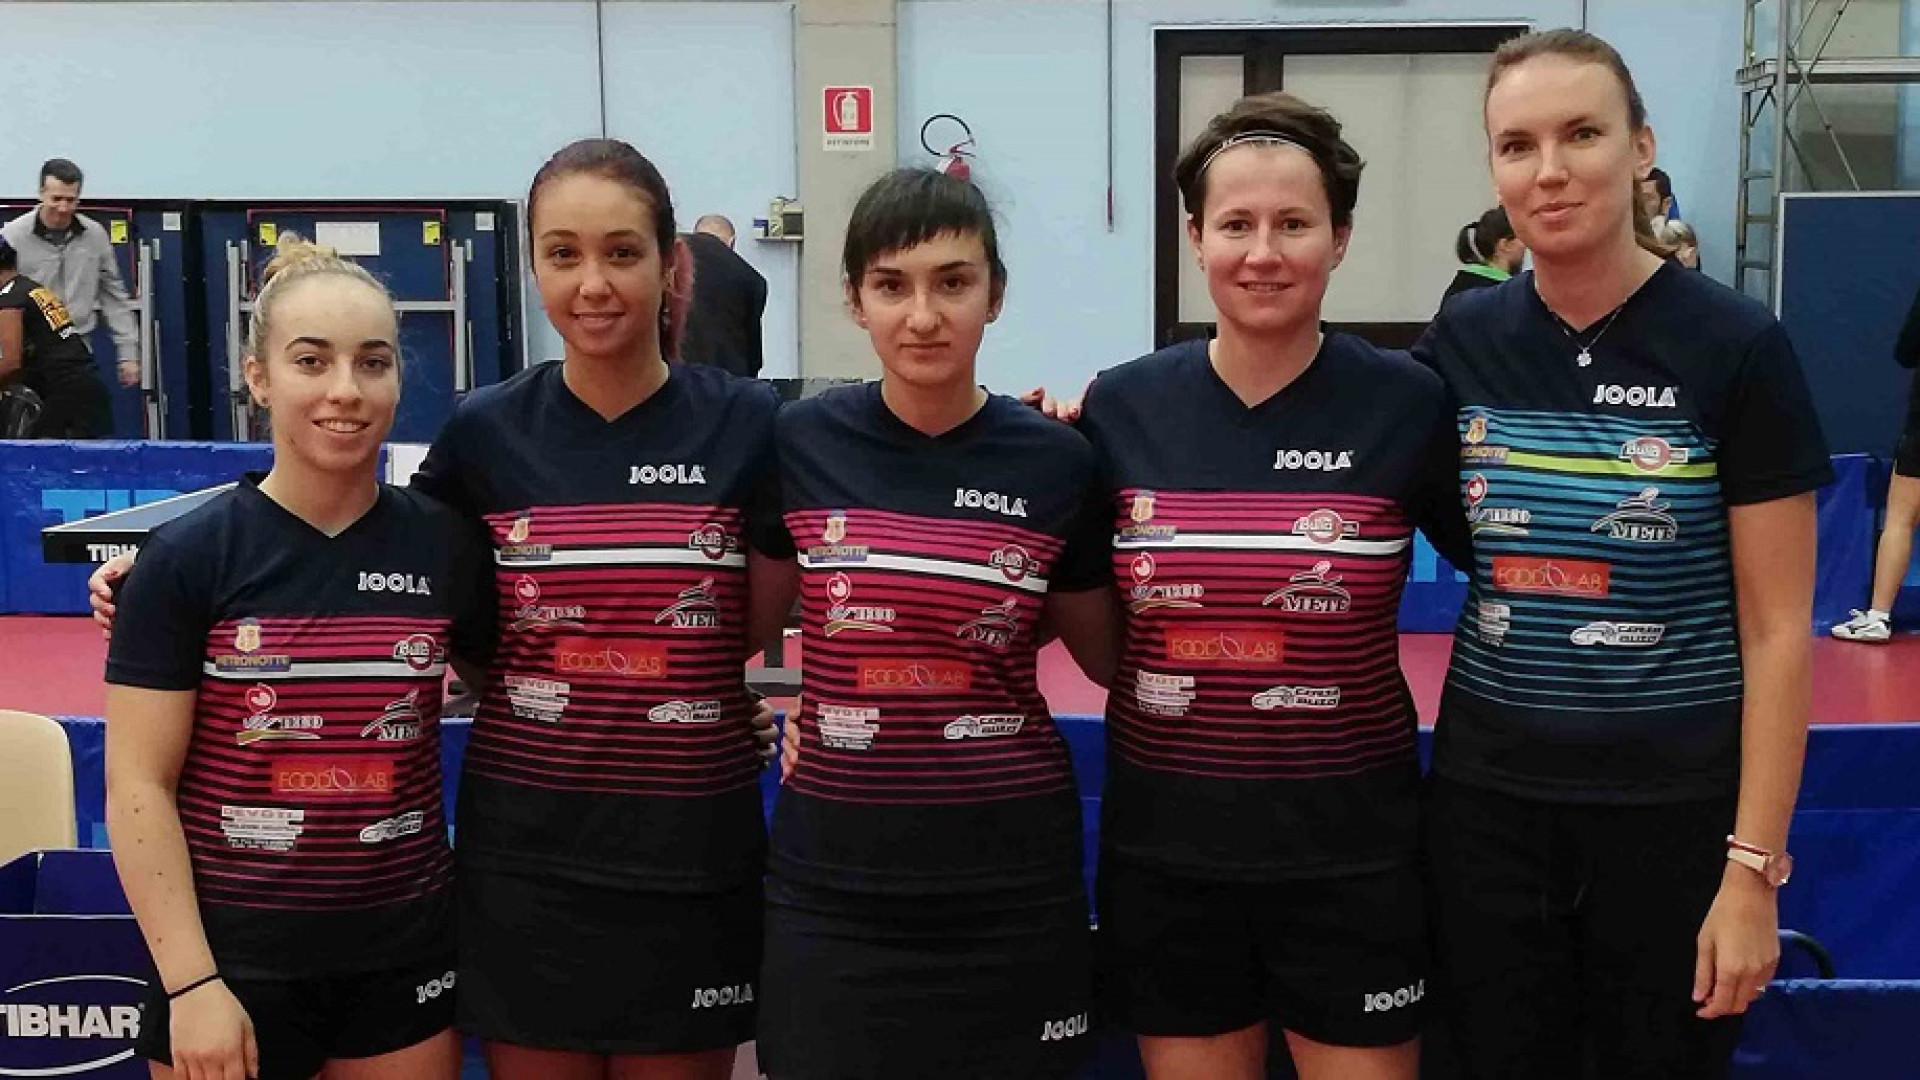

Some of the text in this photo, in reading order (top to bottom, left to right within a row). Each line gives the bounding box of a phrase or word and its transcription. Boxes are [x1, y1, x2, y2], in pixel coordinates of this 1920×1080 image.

[1593, 384, 1677, 408] JOOLA
[1273, 450, 1353, 472] JOOLA
[629, 464, 707, 485] JOOLA
[954, 488, 1028, 518] JOOLA
[357, 571, 431, 596] JOOLA
[672, 611, 718, 629] MET
[0, 1003, 142, 1039] IBHAR
